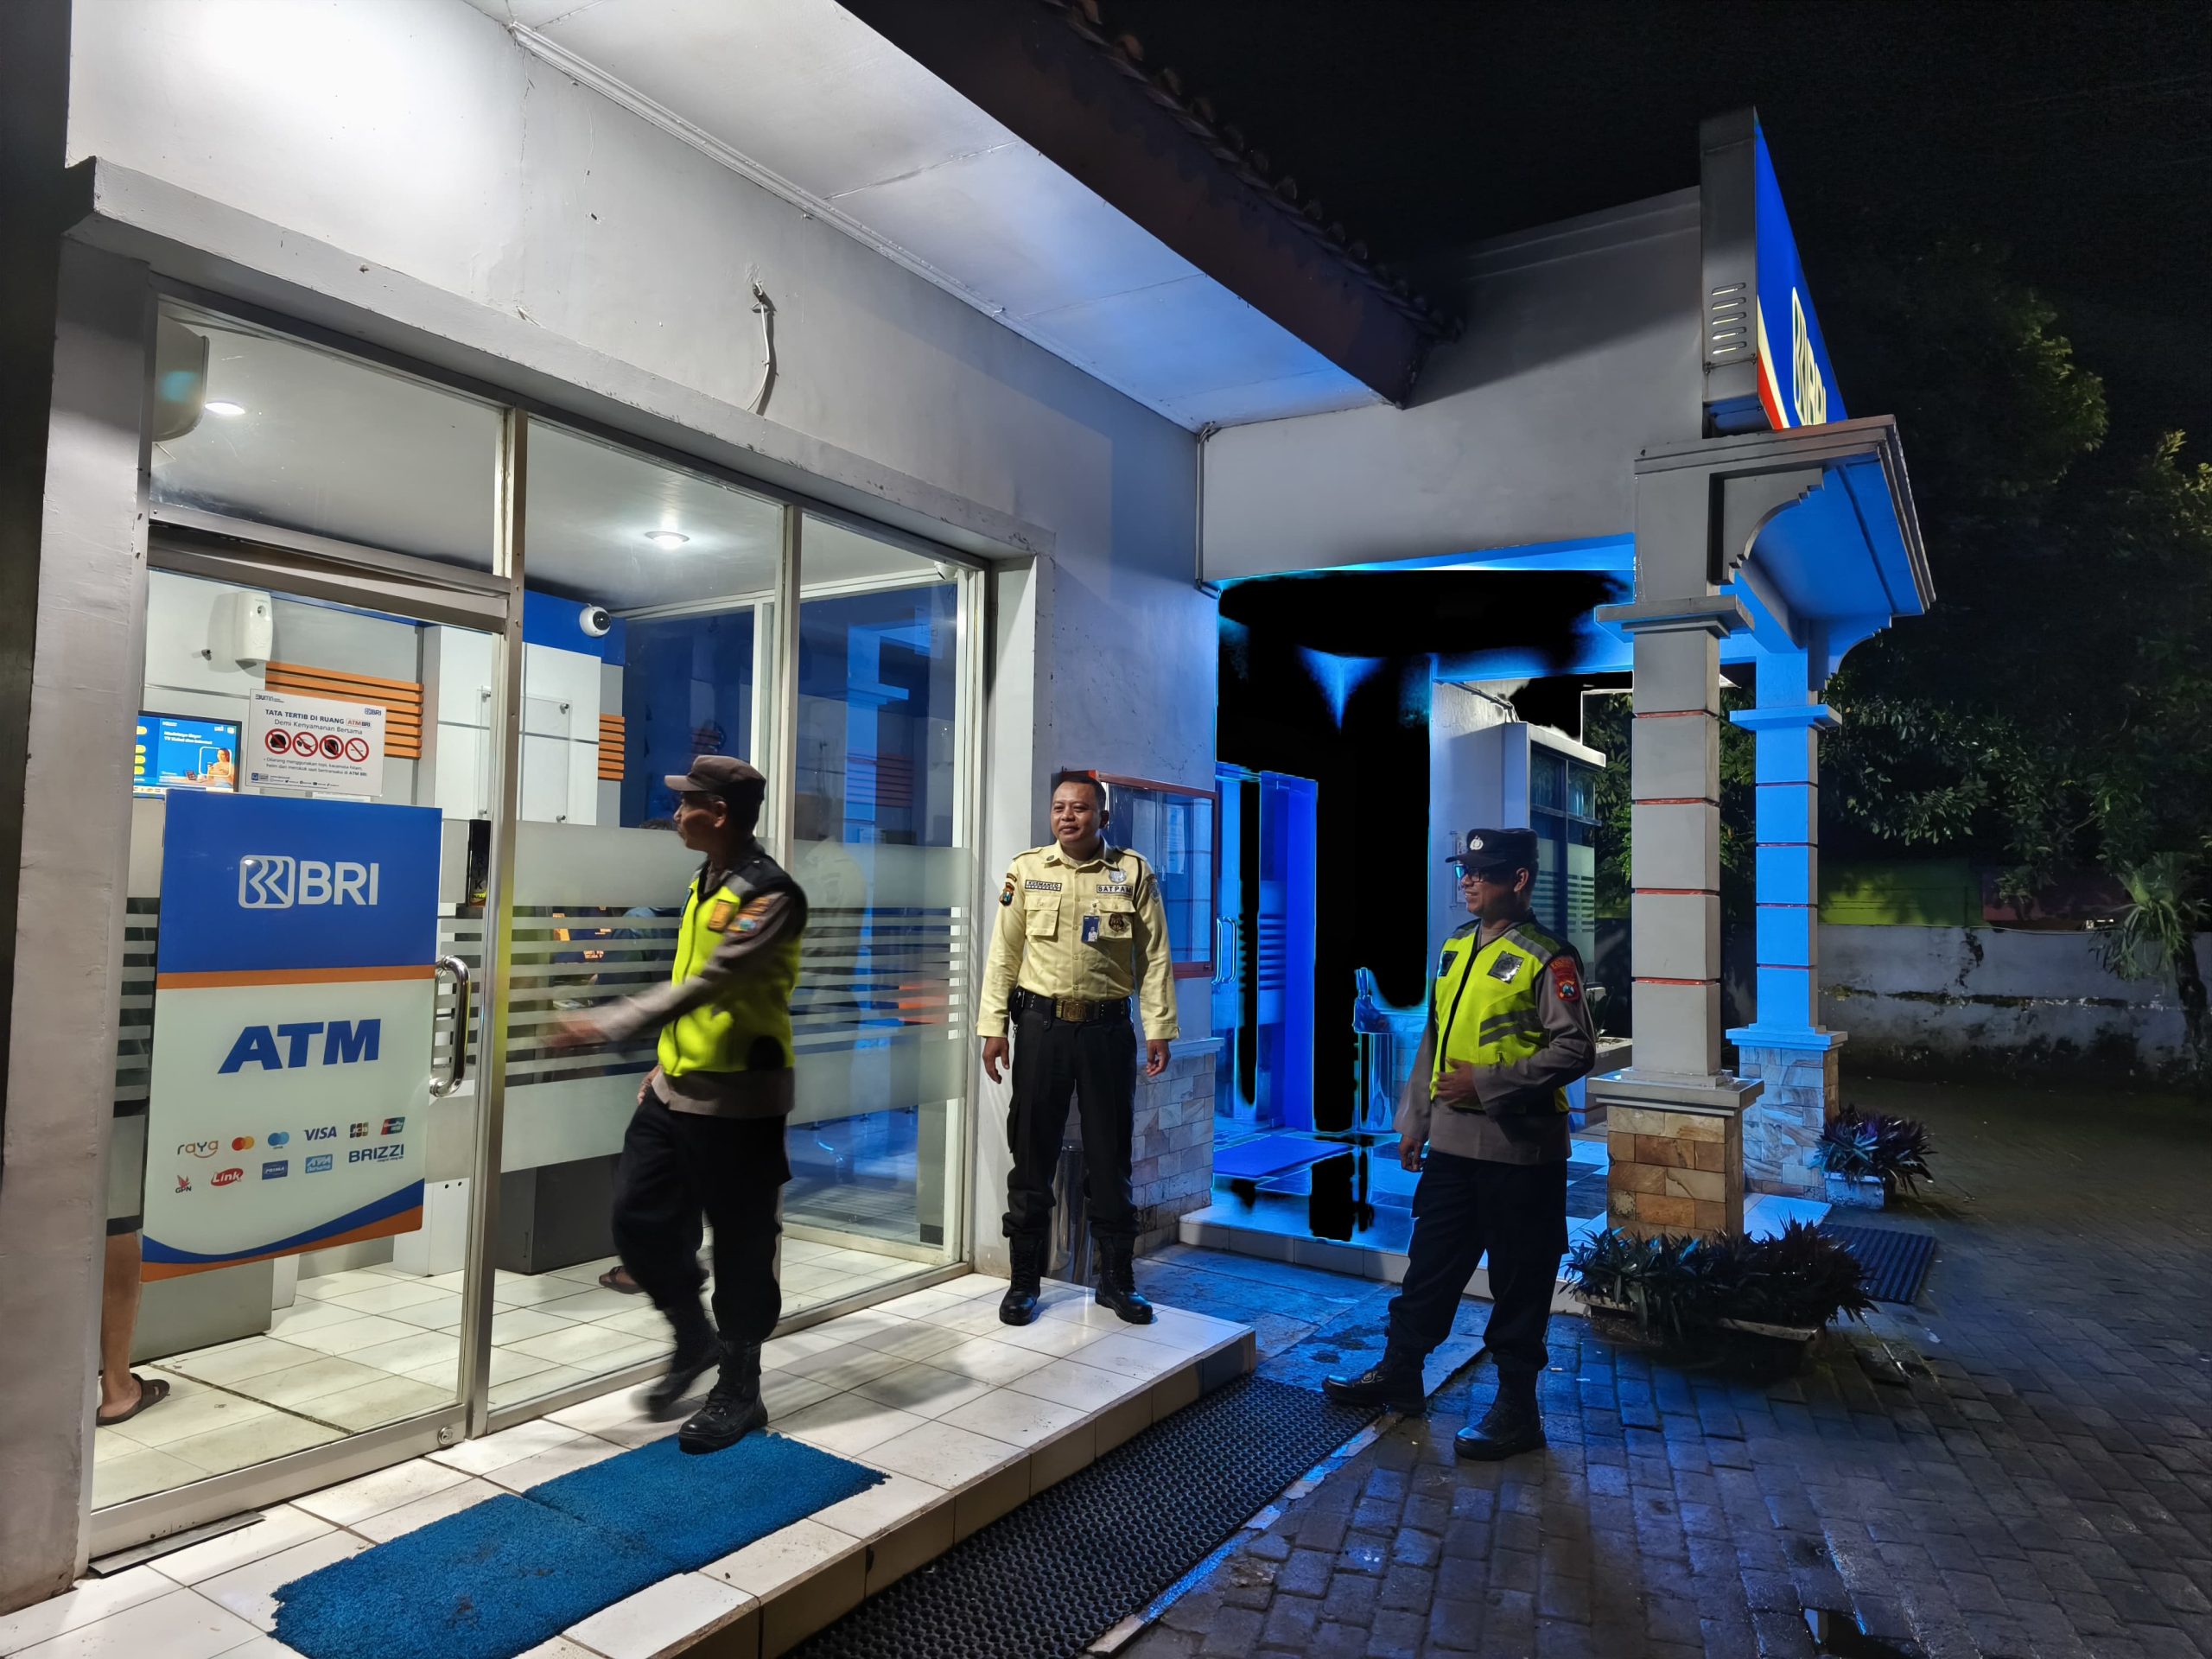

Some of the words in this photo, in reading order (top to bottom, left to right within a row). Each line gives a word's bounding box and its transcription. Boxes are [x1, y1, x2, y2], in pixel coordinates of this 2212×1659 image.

[265, 709, 283, 717] TATA
[284, 711, 308, 720] TERTIB
[320, 715, 344, 724] RUANG
[294, 721, 335, 732] Kenyamanan
[336, 727, 363, 735] Bersama
[298, 860, 379, 906] BRI
[217, 1018, 381, 1074] ATM
[304, 1126, 337, 1141] VISA
[348, 1144, 404, 1163] BRIZZI
[212, 1172, 243, 1183] Link
